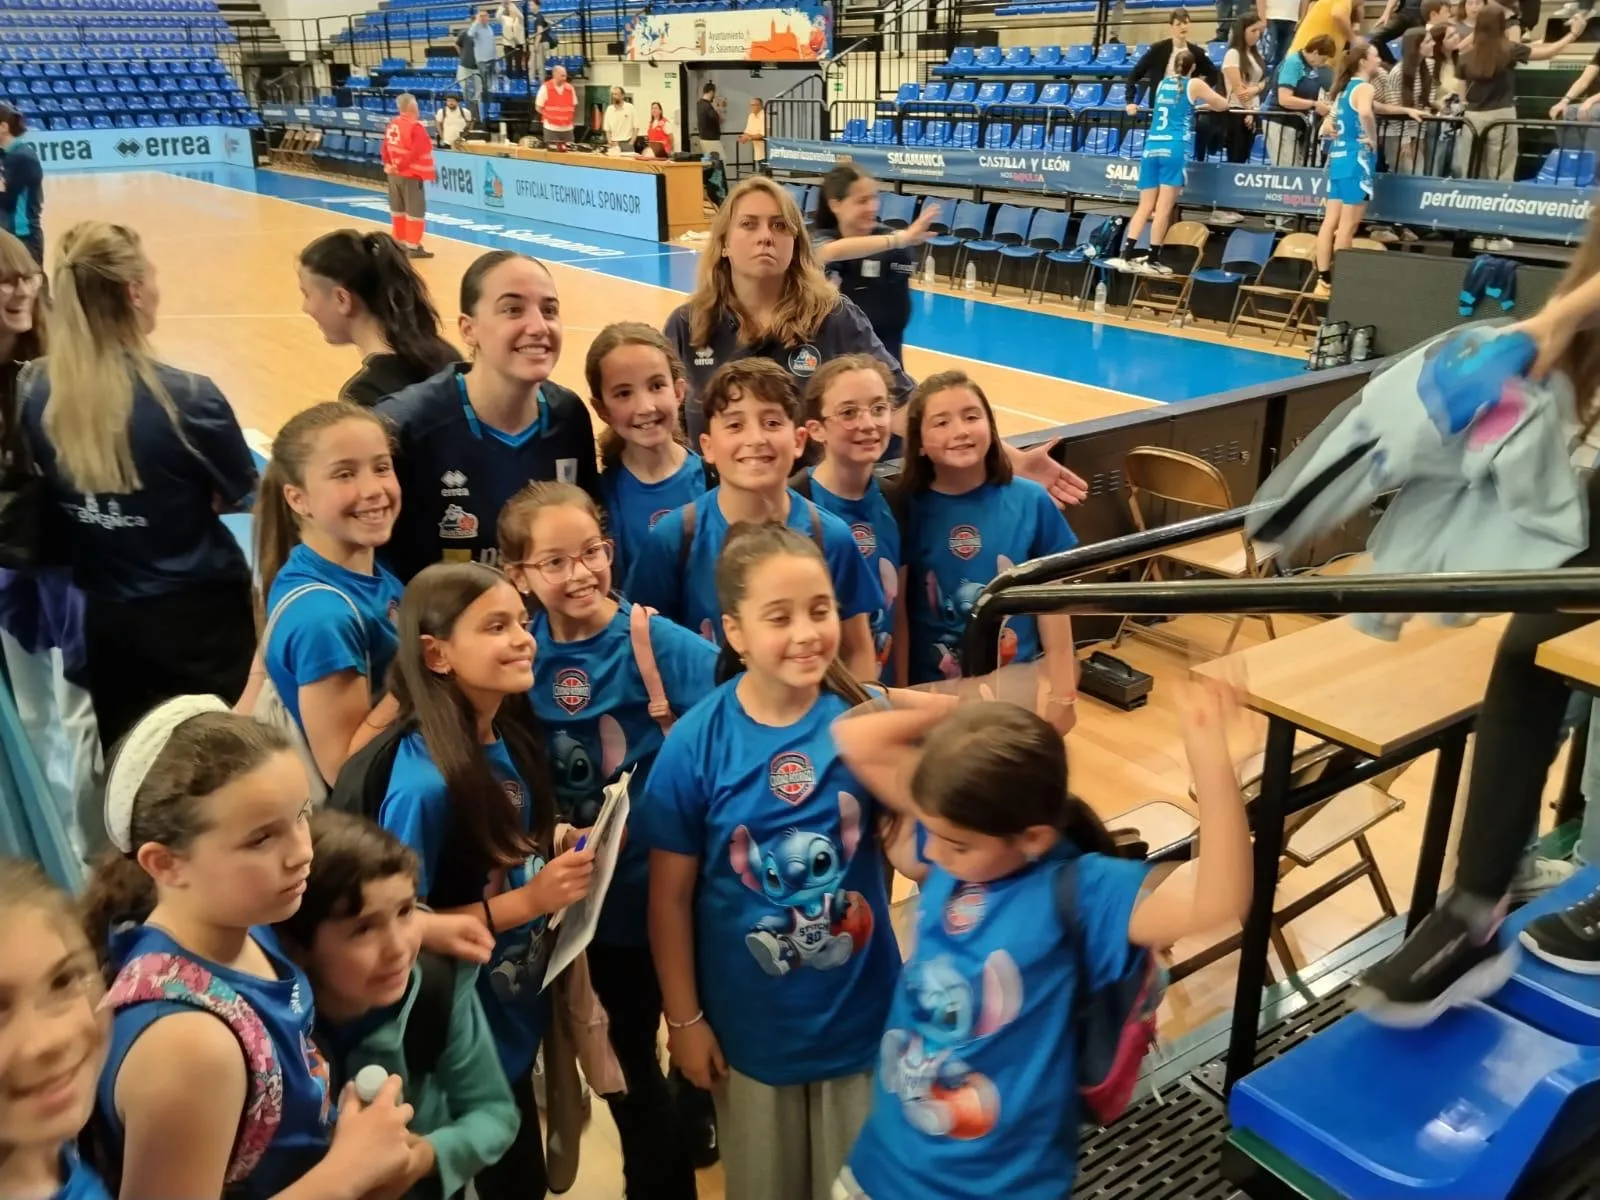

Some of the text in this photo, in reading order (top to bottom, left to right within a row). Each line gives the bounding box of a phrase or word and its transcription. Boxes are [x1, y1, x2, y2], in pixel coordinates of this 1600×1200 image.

[1155, 106, 1169, 131] 3
[887, 152, 945, 168] SALAMANCA
[978, 155, 1071, 172] CASTILLA Y LEÓN
[1105, 163, 1140, 180] SALA
[1234, 172, 1303, 191] CASTILLA
[1310, 177, 1322, 194] Y
[516, 179, 641, 214] OFFICIAL TECHNICAL SPONSOR
